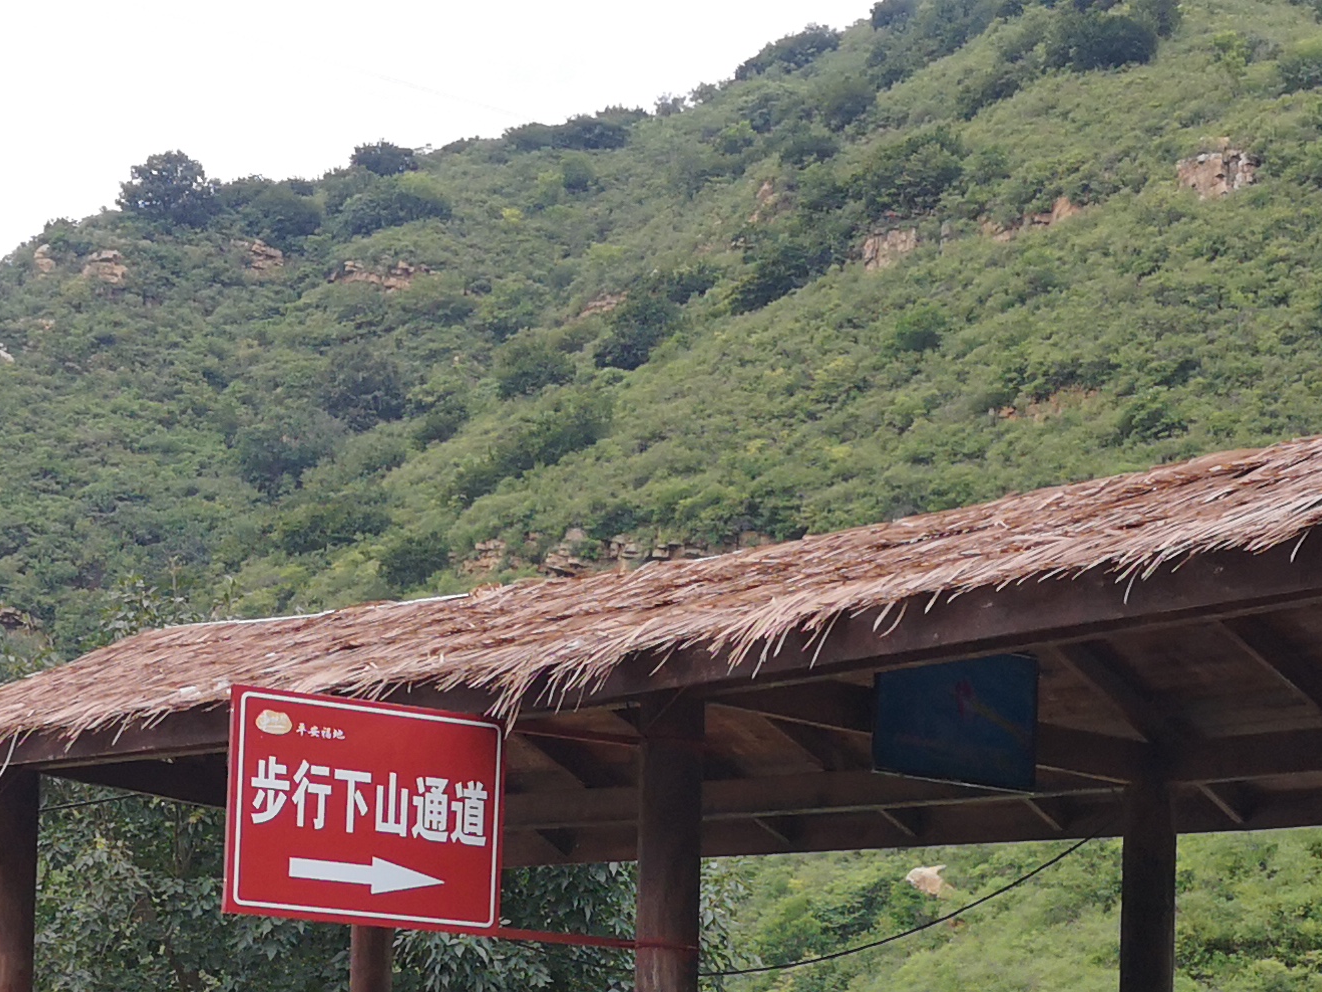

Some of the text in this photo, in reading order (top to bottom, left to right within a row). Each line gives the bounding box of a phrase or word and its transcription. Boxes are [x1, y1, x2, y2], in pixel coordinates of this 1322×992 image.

[250, 755, 488, 846] 步行下山通道
